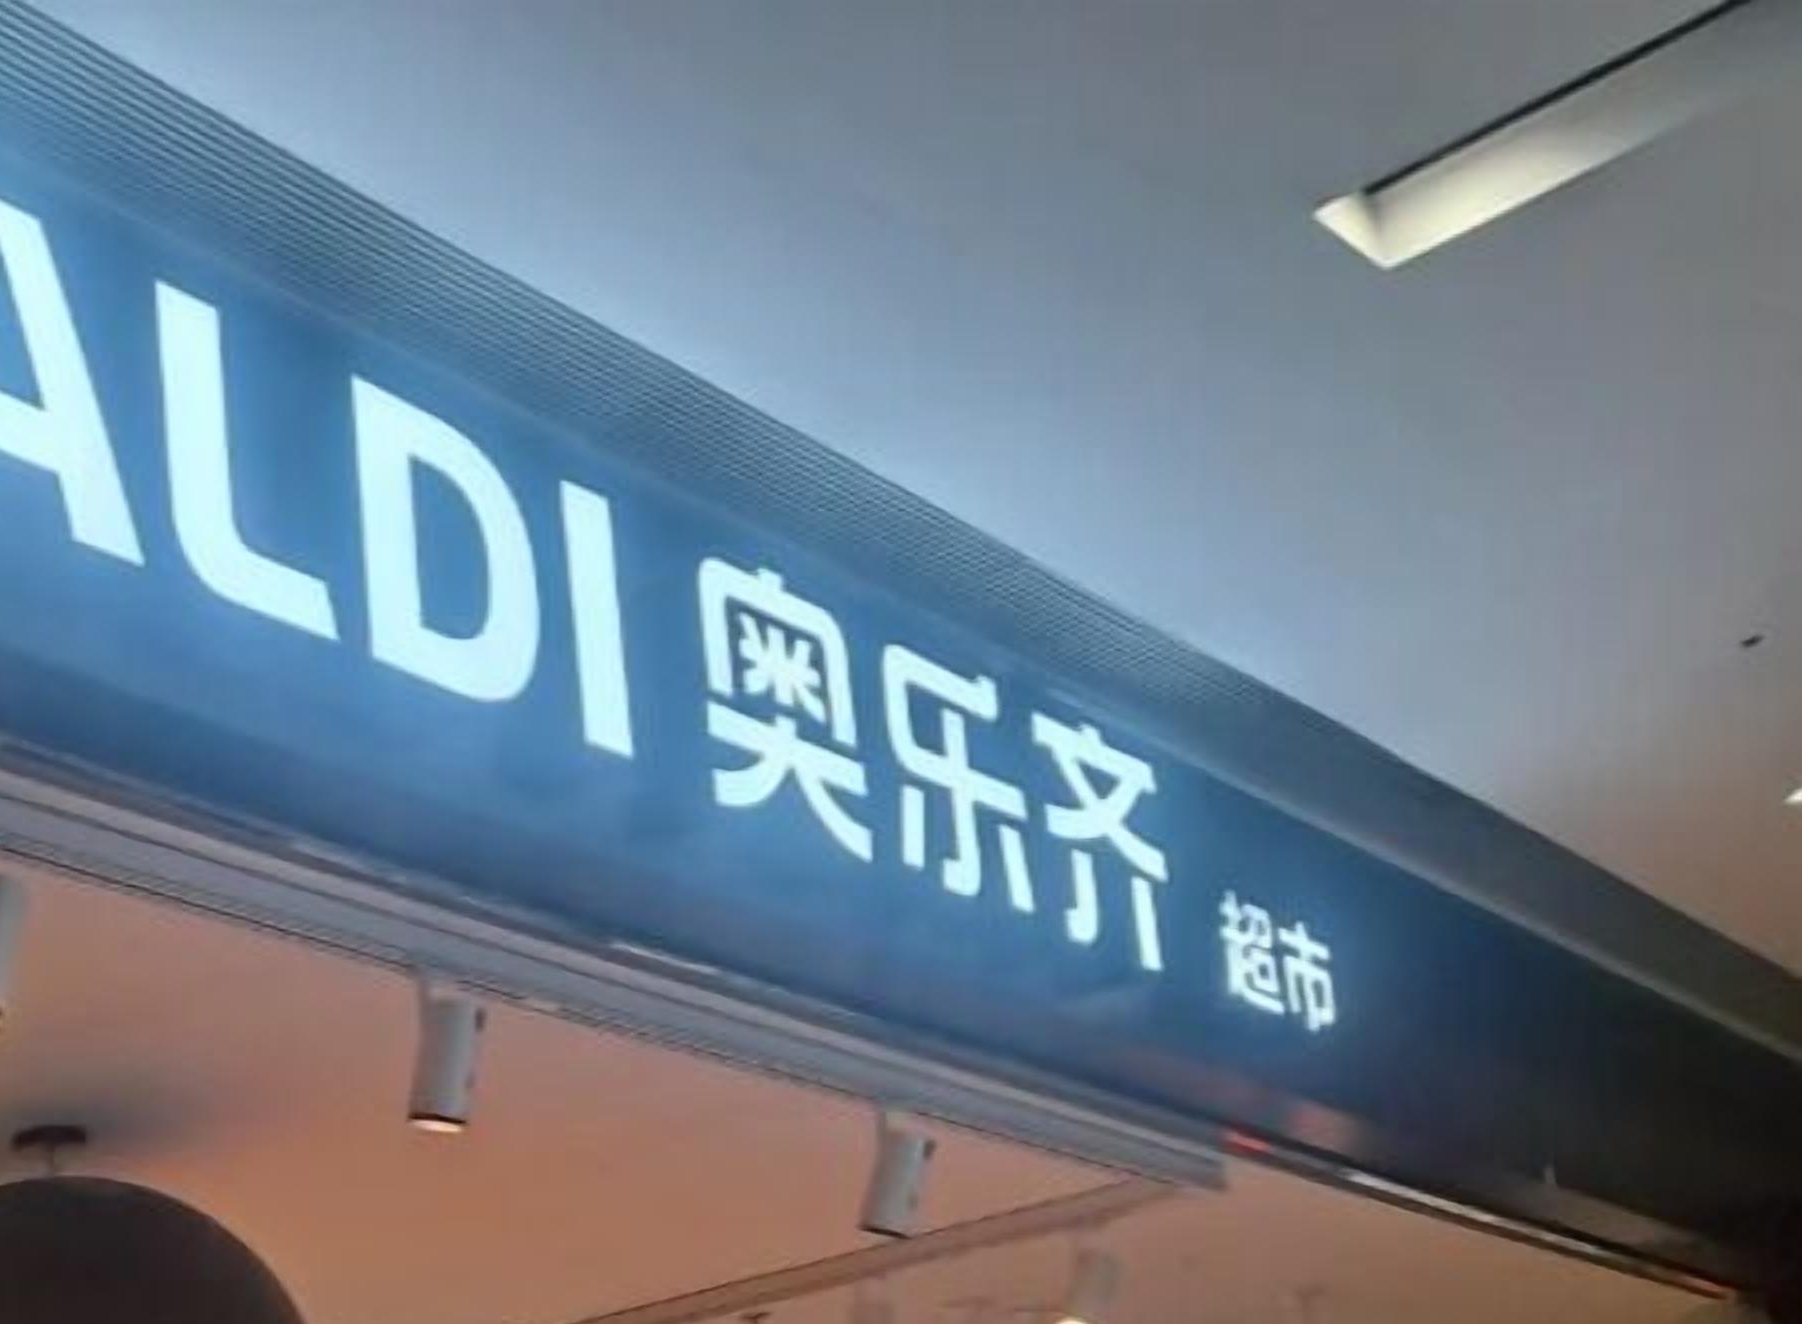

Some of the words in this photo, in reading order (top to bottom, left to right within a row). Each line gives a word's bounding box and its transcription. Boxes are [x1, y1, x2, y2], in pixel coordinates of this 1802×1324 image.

[697, 556, 1168, 971] 奥乐齐
[1219, 890, 1336, 1033] 超市
